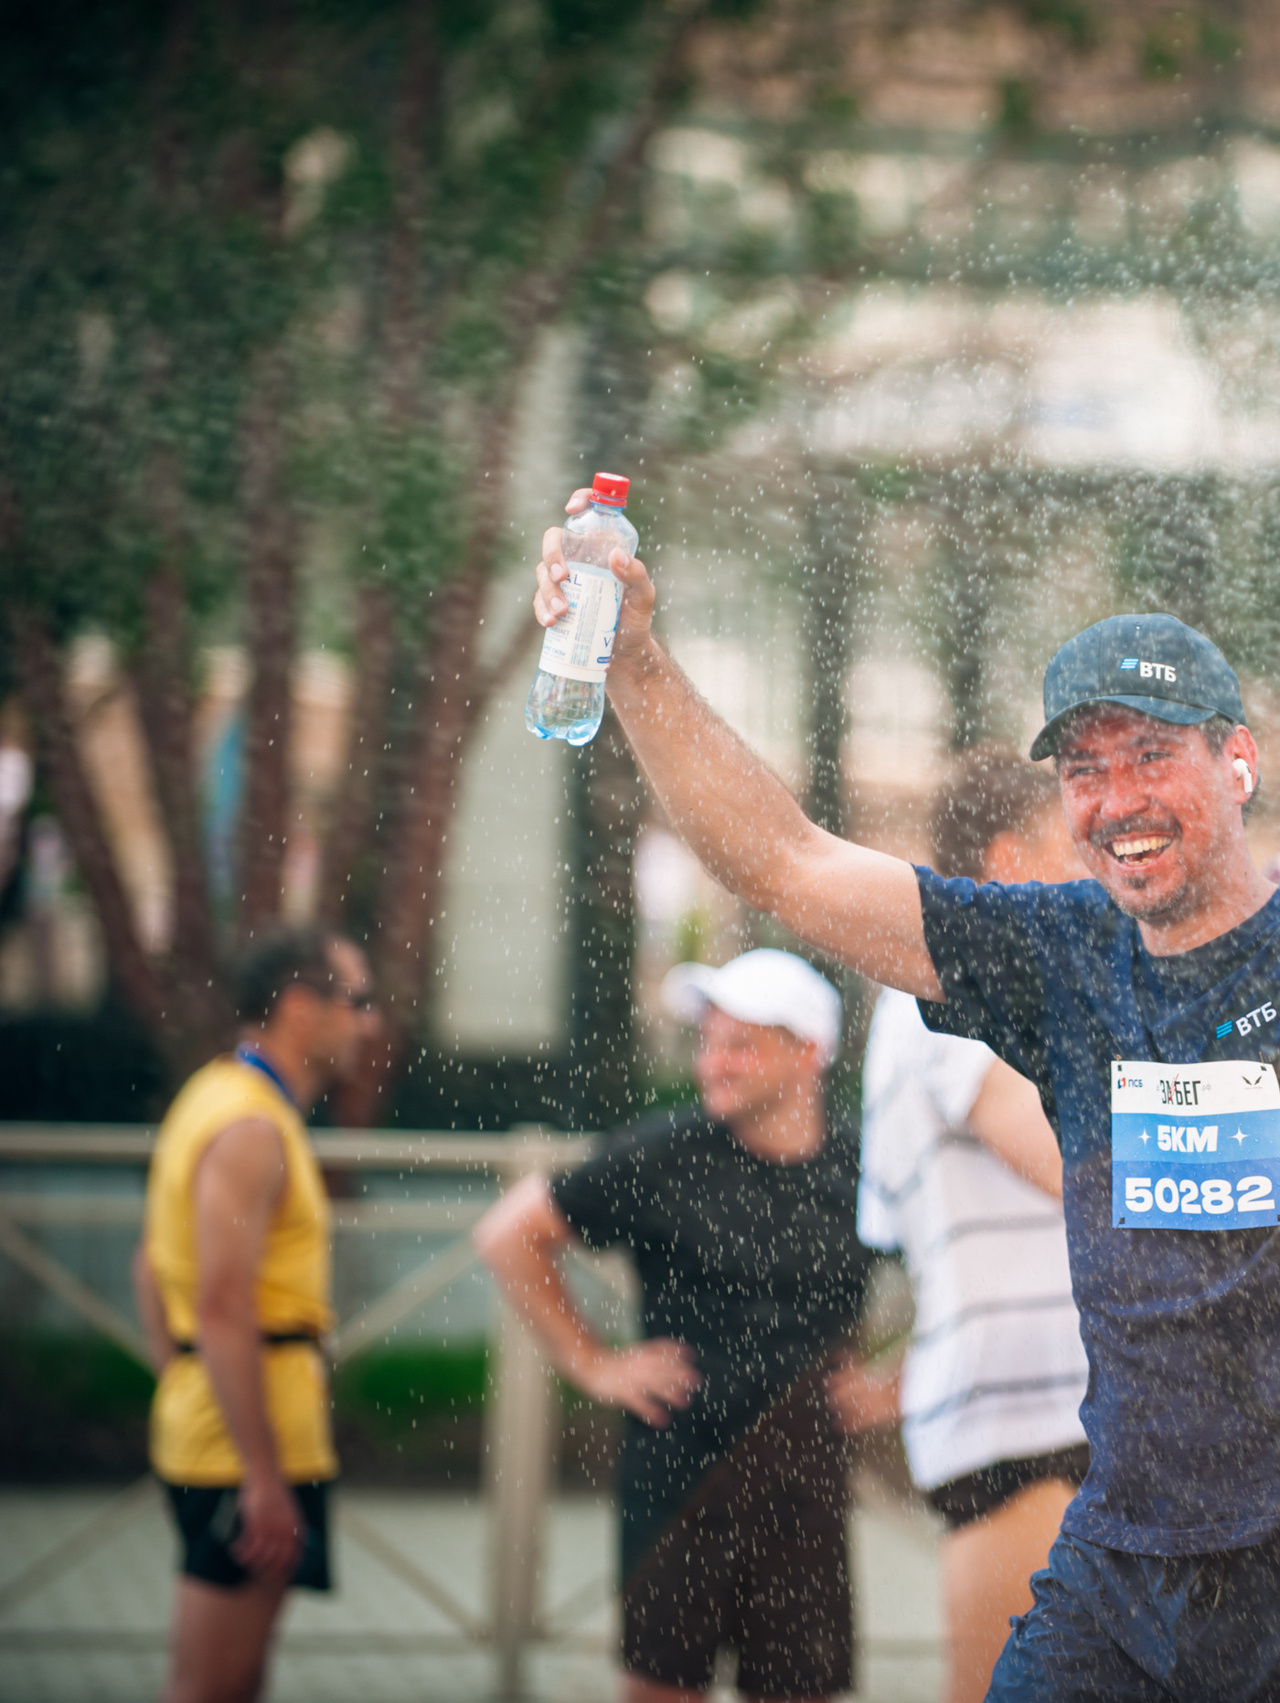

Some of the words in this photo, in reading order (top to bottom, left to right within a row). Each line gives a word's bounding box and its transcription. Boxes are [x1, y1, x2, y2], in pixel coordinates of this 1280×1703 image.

[1140, 661, 1177, 682] ВТБ
[1235, 1001, 1277, 1037] ВТБ
[1125, 1175, 1276, 1215] 50282
